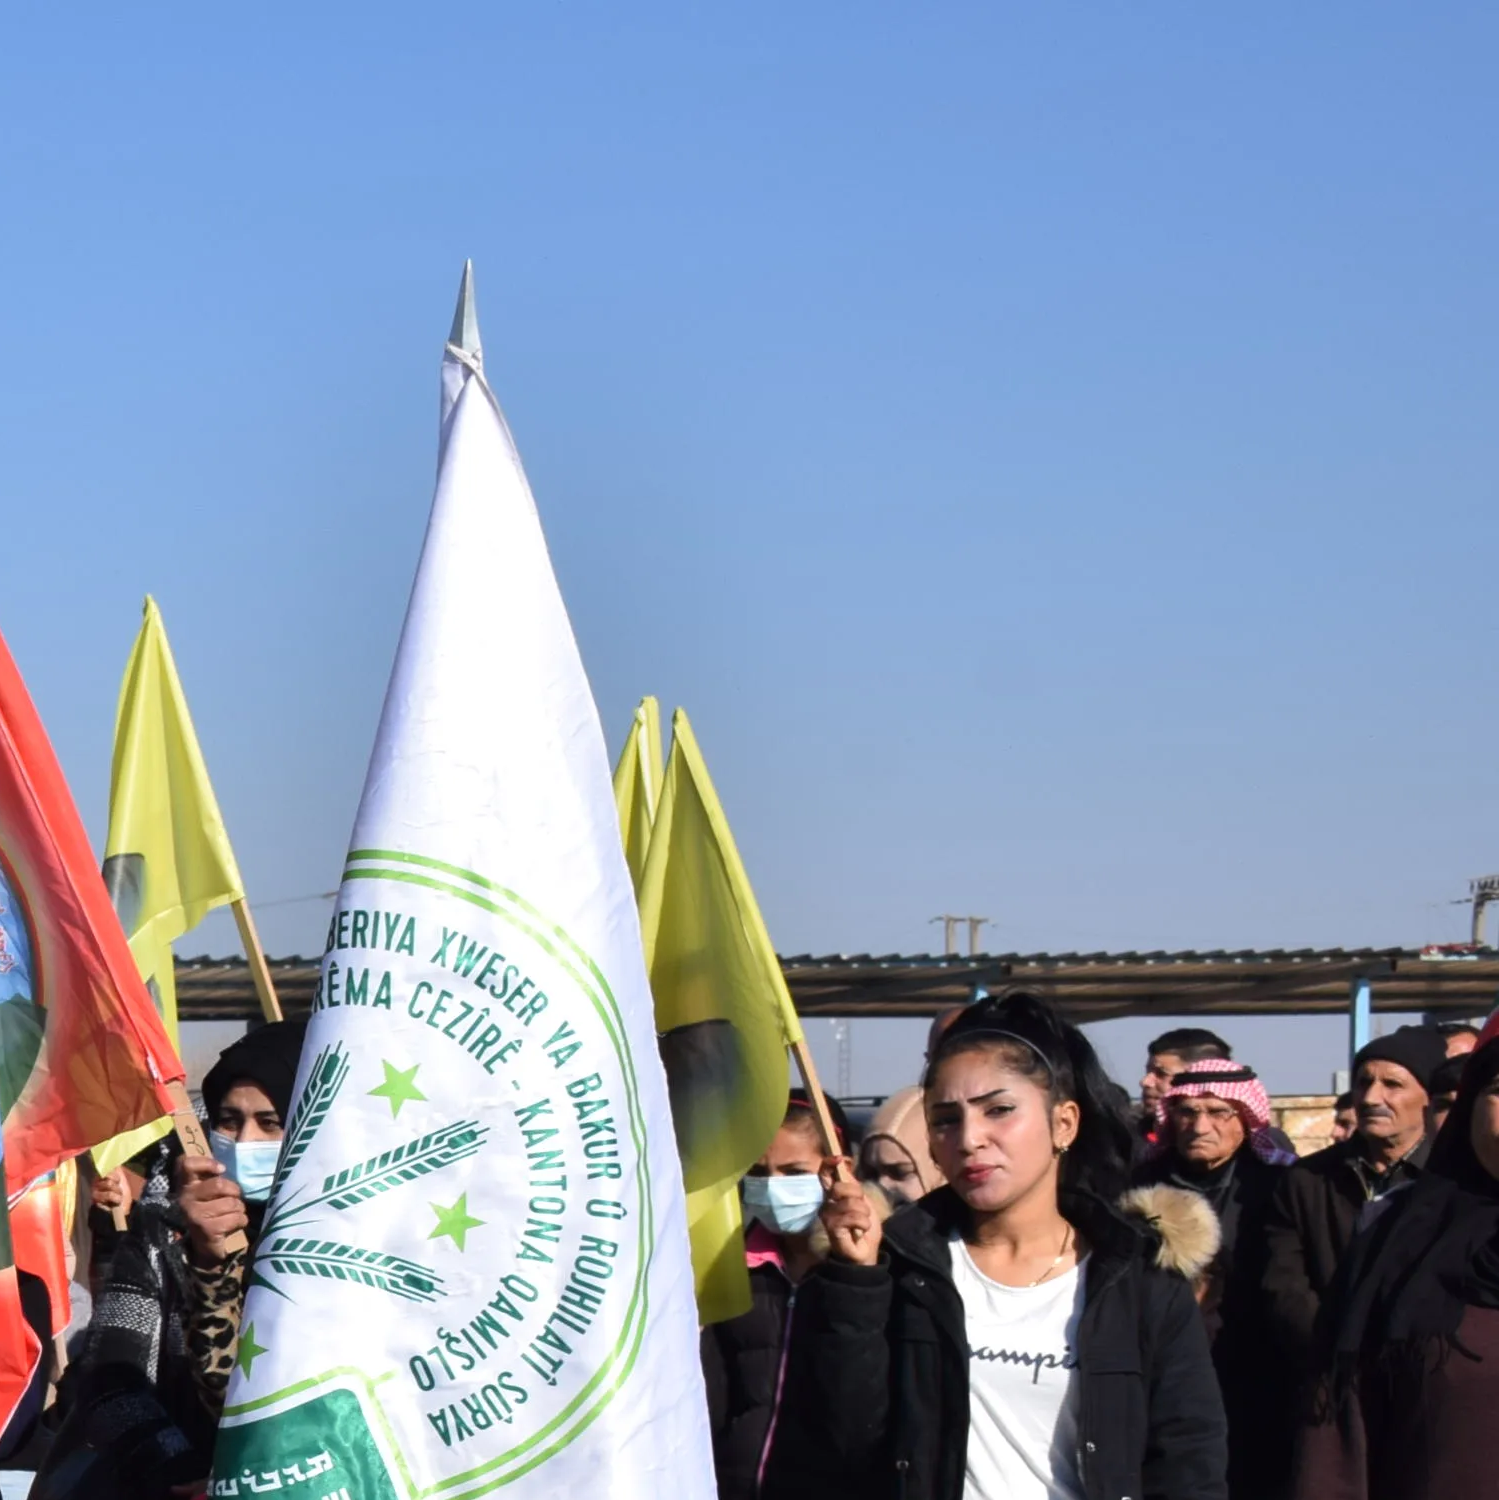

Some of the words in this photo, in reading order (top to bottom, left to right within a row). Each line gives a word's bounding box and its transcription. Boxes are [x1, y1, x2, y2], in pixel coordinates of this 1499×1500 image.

[325, 909, 416, 957] BERIYA
[430, 926, 549, 1027] XWESER
[311, 959, 392, 1014] RÊMA
[407, 980, 523, 1075] CEZÎRÊ
[541, 1020, 583, 1069] YA
[564, 1072, 622, 1180] BAKUR
[513, 1098, 567, 1264] KANTONA
[585, 1198, 628, 1220] Û
[408, 1274, 539, 1392] QAMIŞLO
[521, 1234, 619, 1387] ROJHILATÎ
[426, 1371, 529, 1447] SÛRYA
